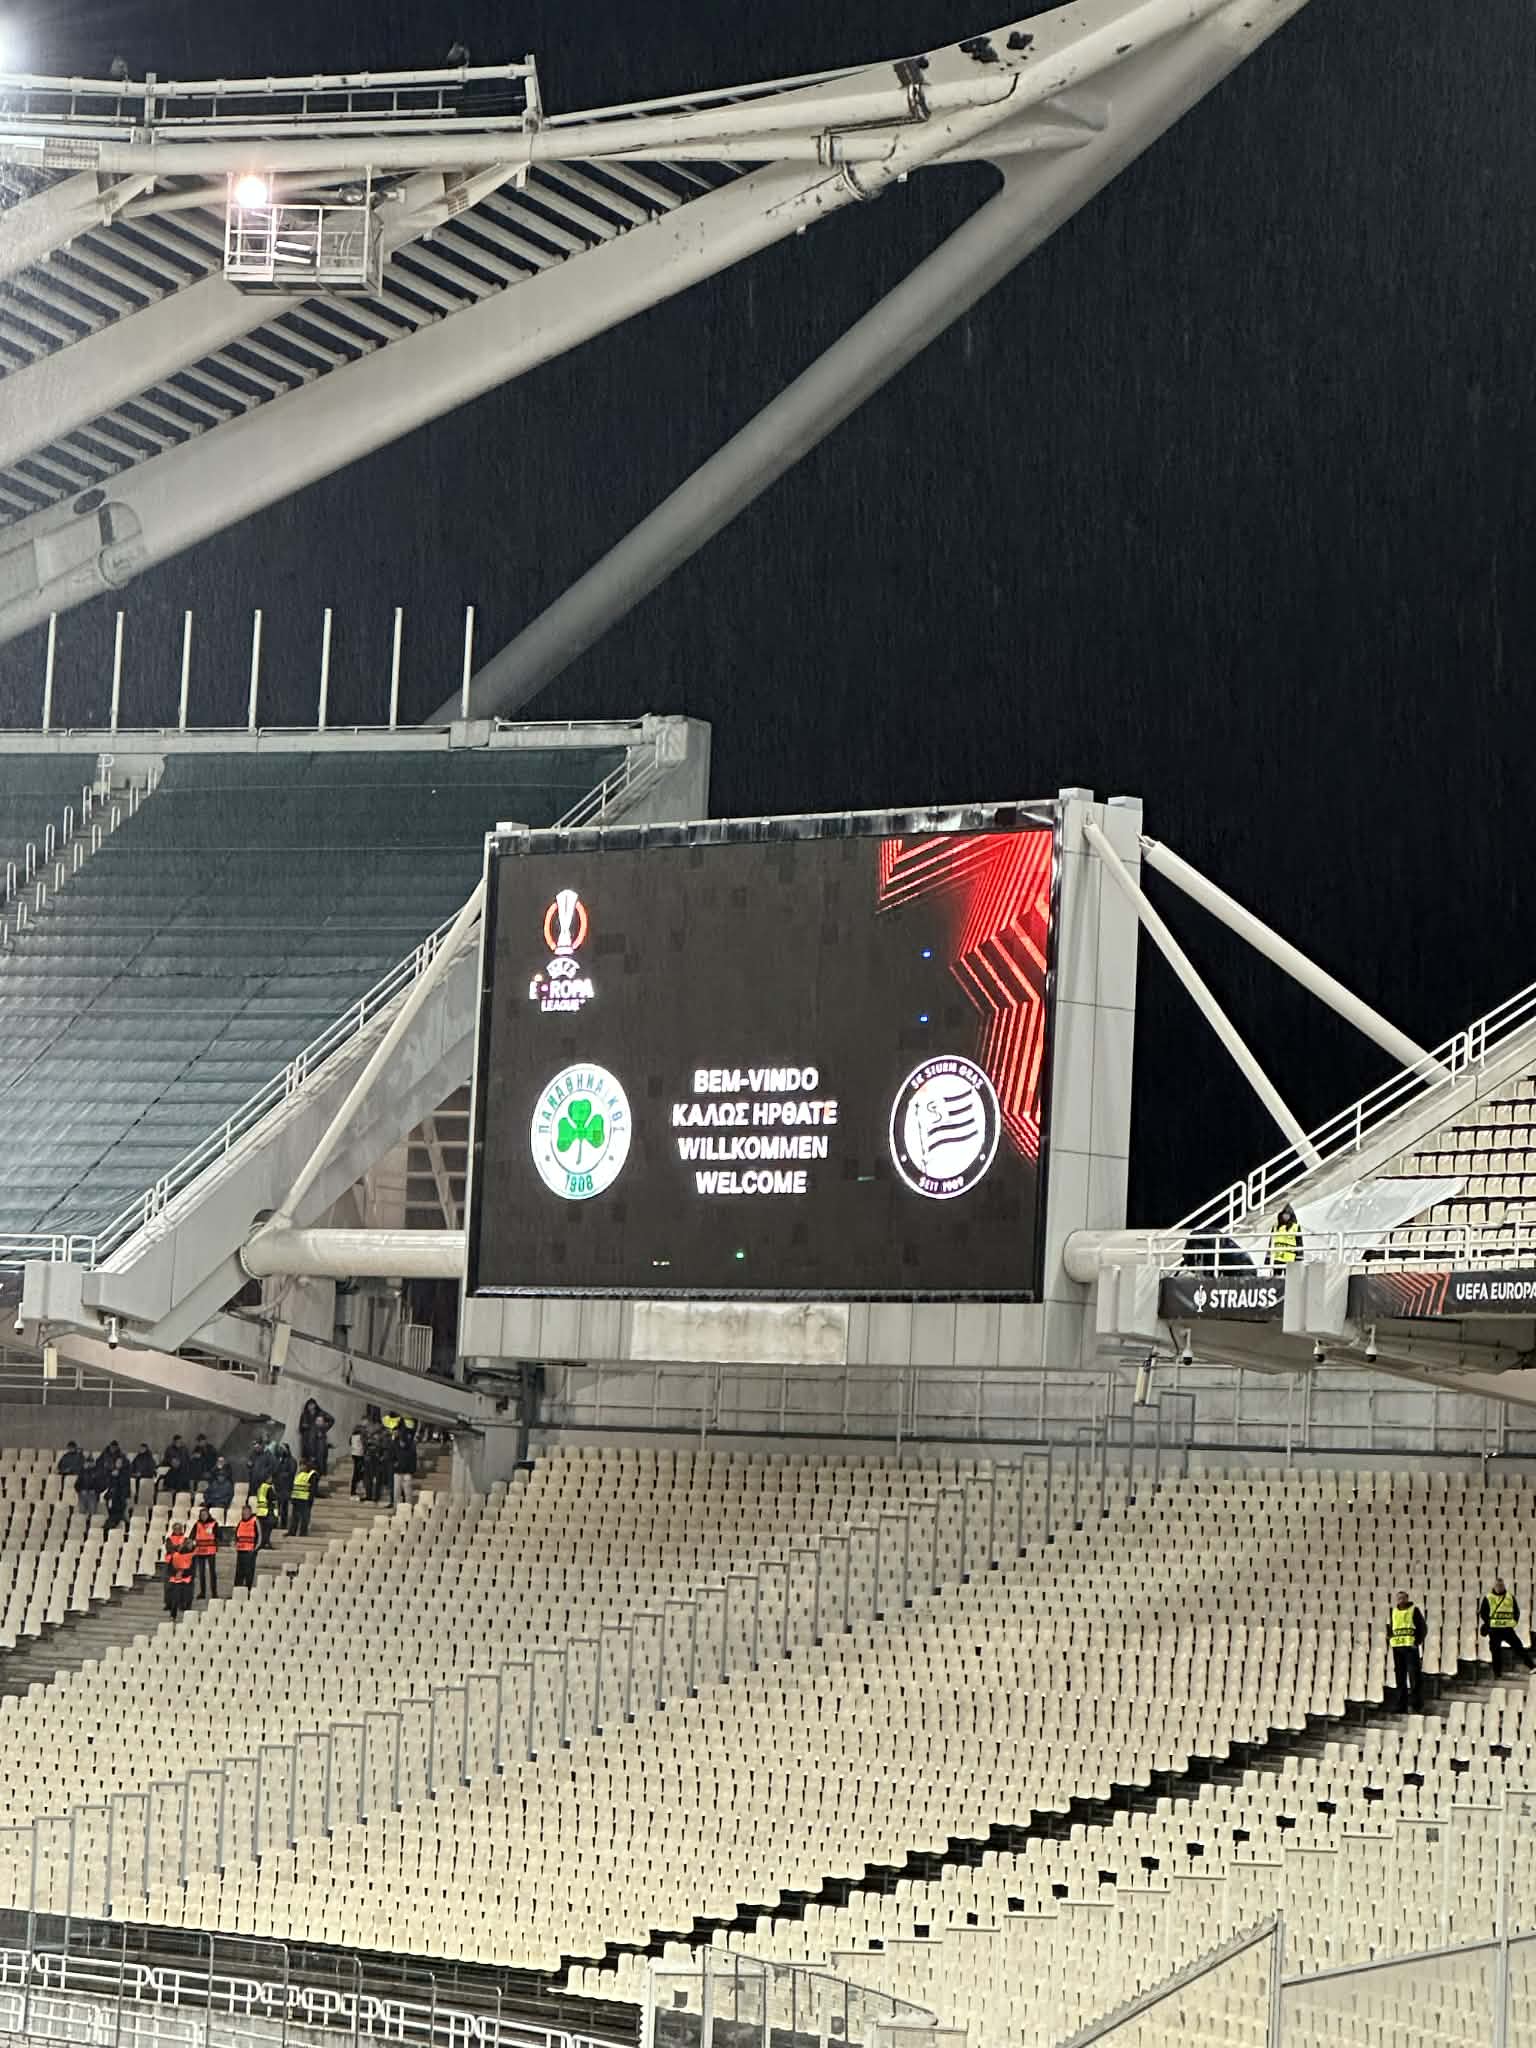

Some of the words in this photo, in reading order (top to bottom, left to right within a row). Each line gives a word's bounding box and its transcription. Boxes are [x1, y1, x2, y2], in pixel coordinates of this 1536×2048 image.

[694, 1067, 819, 1093] BEM-VINDO
[924, 1062, 957, 1078] STURM
[672, 1102, 749, 1127] ΚΑΛΩΣ
[752, 1100, 838, 1126] ΗΡΘΑΤΕ
[677, 1135, 828, 1160] WILLKOMMEN
[564, 1171, 594, 1193] 1908
[695, 1169, 808, 1194] WELCOME
[1208, 1286, 1278, 1309] STRAUSS
[1456, 1283, 1488, 1300] UEFA
